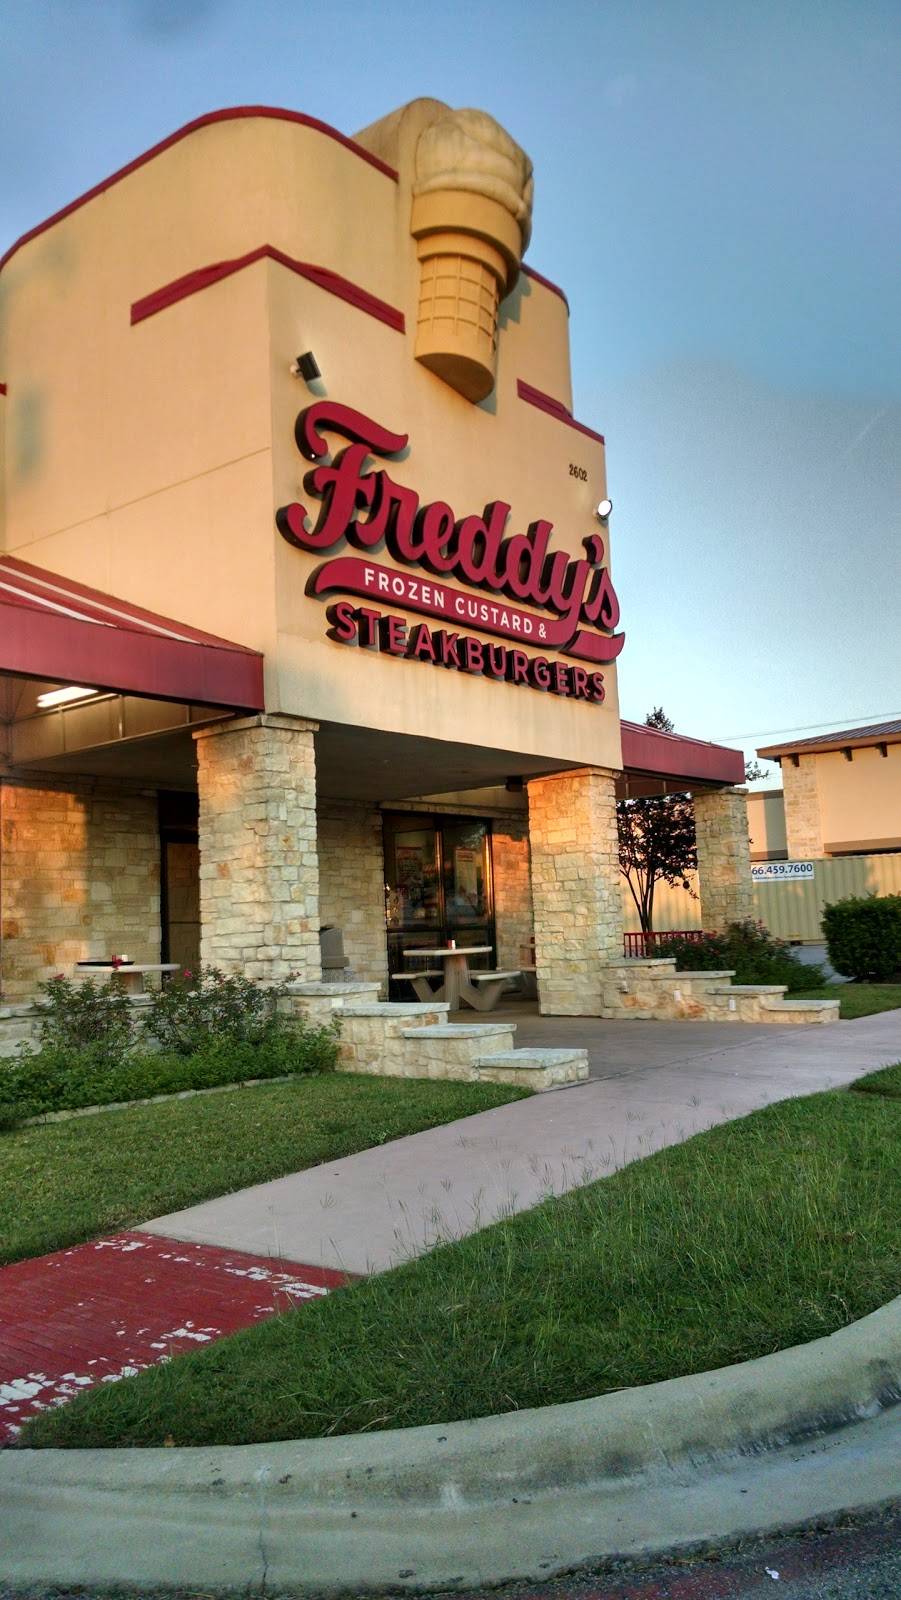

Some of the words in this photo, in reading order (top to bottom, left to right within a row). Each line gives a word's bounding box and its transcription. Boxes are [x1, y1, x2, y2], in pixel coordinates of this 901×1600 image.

[277, 400, 621, 630] Freddy's
[569, 463, 588, 482] 2602
[364, 567, 445, 609] FROZEN
[455, 597, 533, 634] CUSTARD
[538, 622, 547, 639] &
[327, 601, 606, 703] STEAKBURGERS
